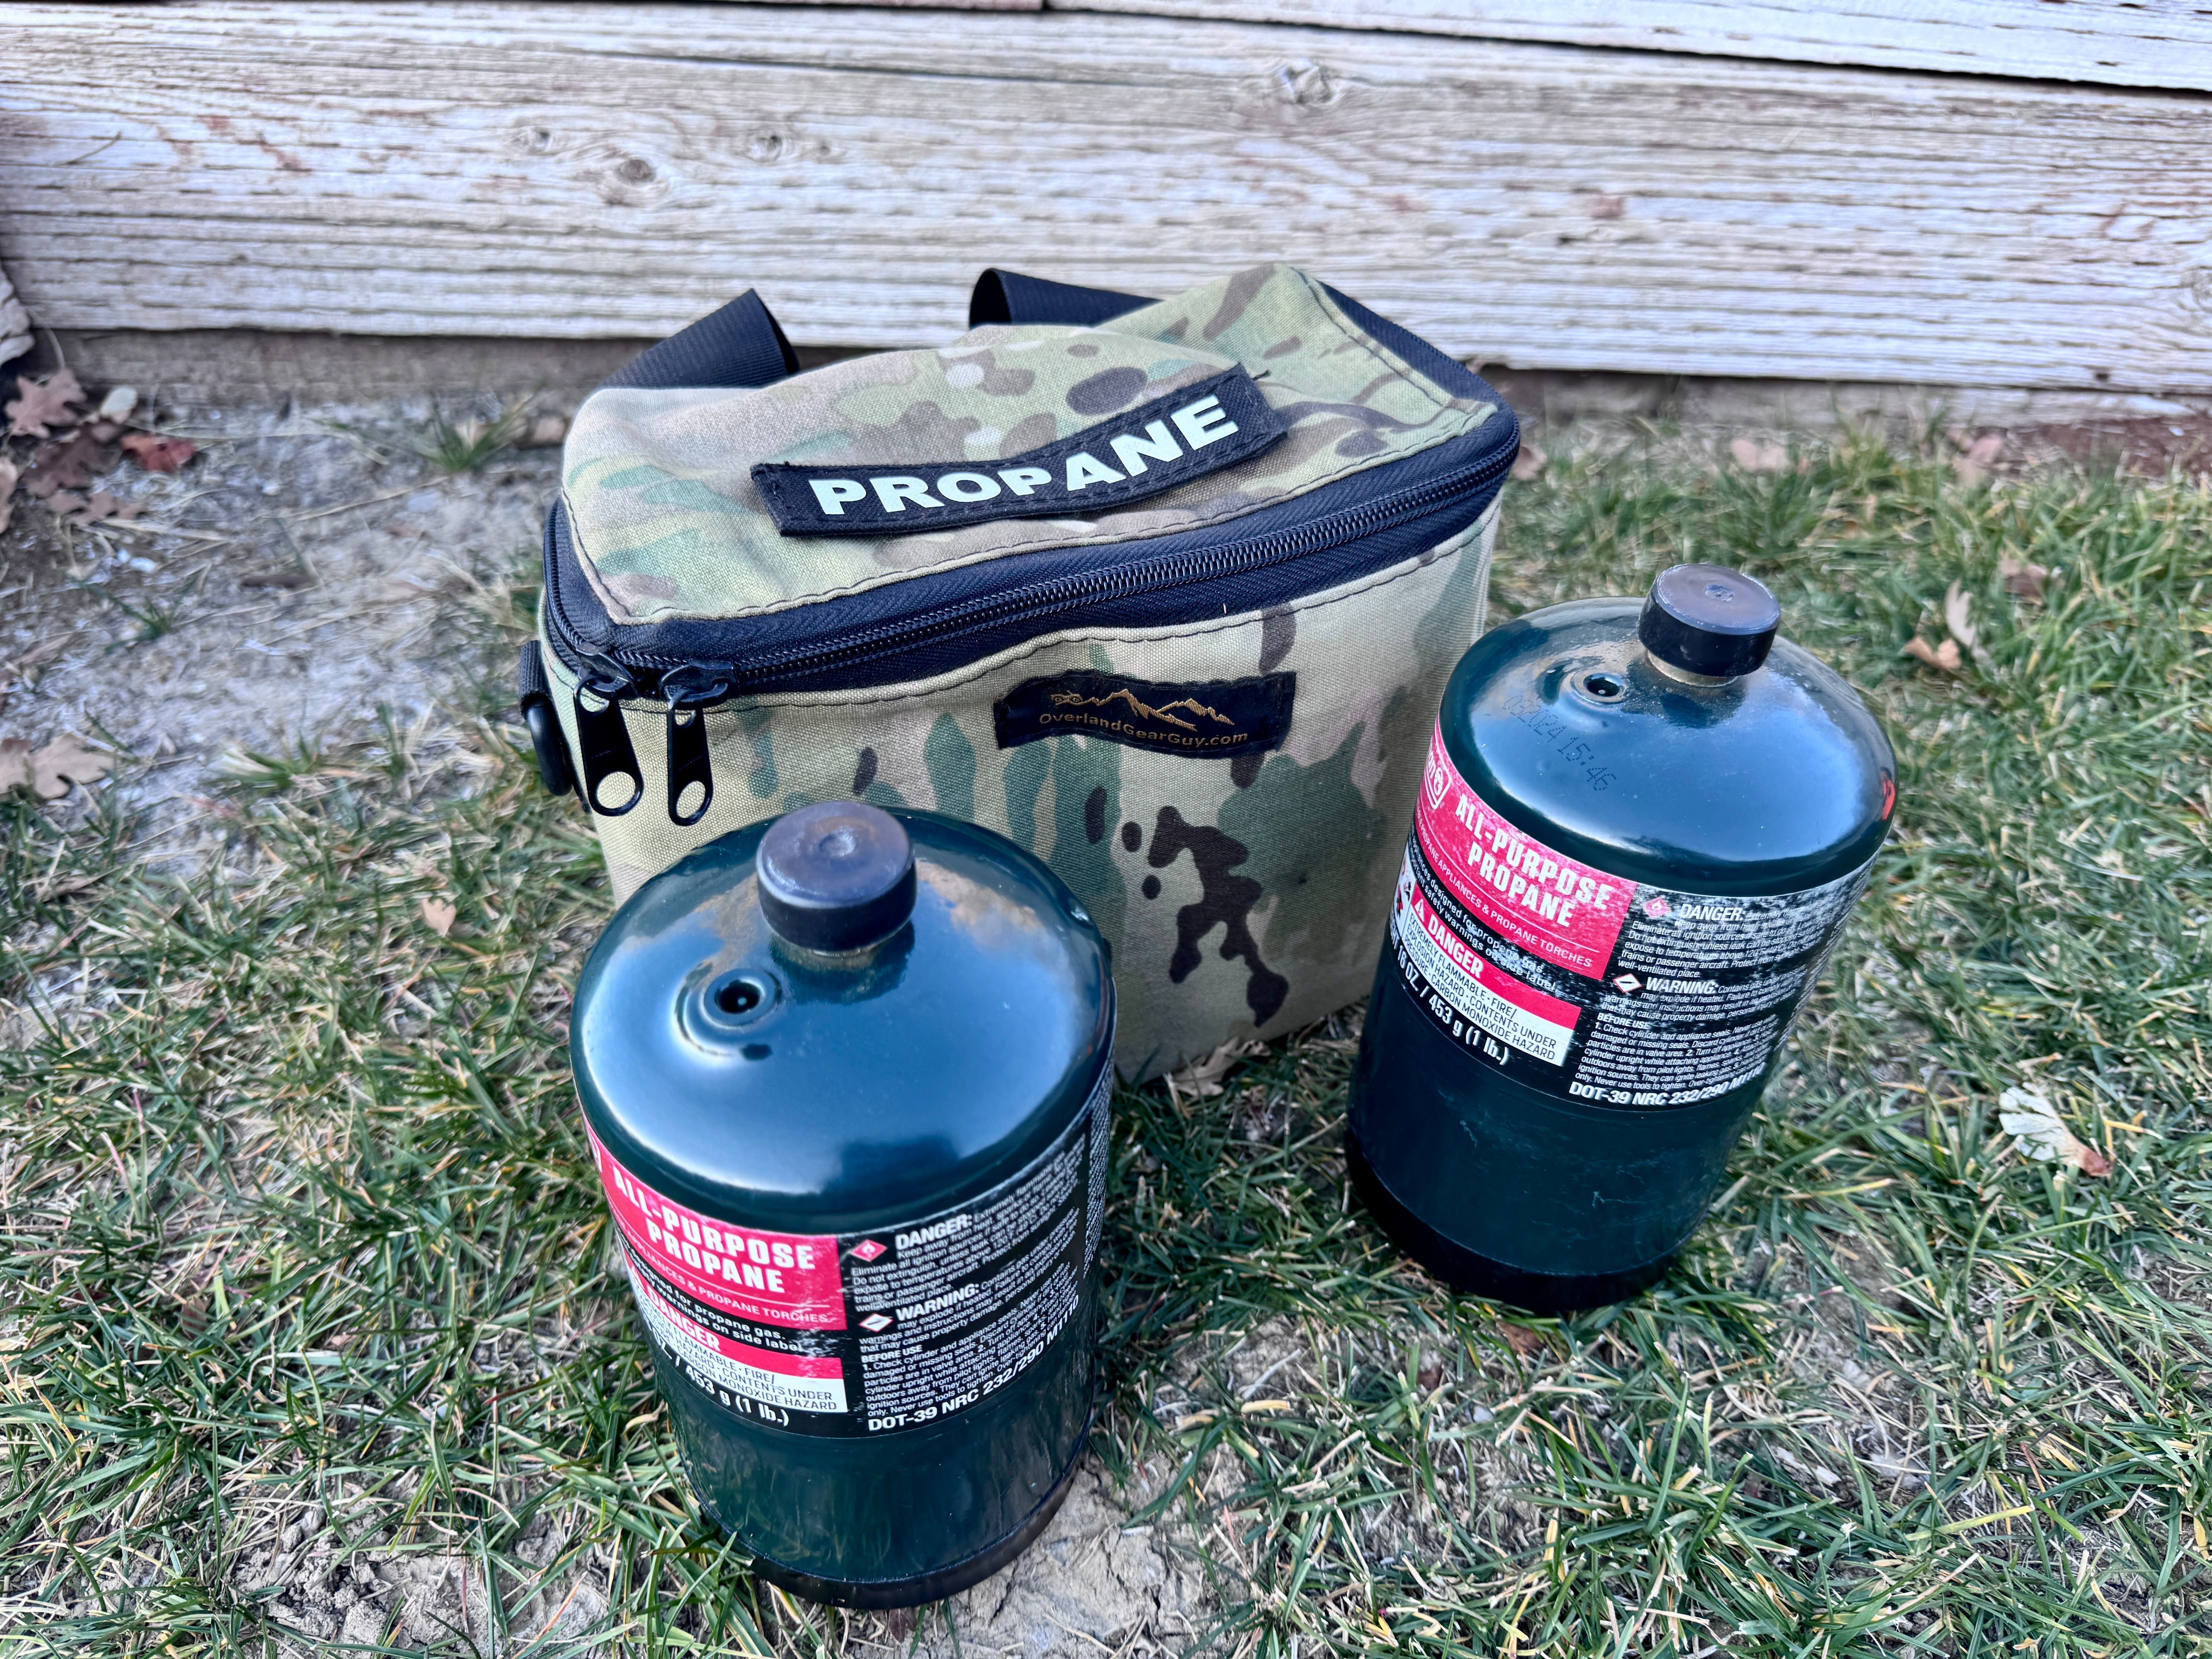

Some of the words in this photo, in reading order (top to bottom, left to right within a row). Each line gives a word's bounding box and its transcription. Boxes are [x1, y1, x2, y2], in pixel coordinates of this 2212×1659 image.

[808, 394, 1239, 516] PROPANE
[1039, 713, 1248, 748] OverlandGearGuy.com
[1558, 737, 1617, 790] 15:46
[1455, 793, 1614, 910] ALL-PURPOSE
[1431, 879, 1463, 918] designed
[1467, 841, 1575, 927] PROPANE
[1424, 885, 1444, 914] safety
[1445, 911, 1484, 951] warnings
[1438, 859, 1481, 908] APPLIANCES
[1482, 904, 1489, 915] &
[1491, 910, 1538, 945] PROPANE
[1540, 939, 1594, 967] TORCHES
[1632, 920, 1670, 935] Eliminate
[1682, 931, 1713, 941] ignition
[1680, 903, 1746, 921] DANGER:
[1409, 913, 1438, 957] EXTREMELY
[1439, 954, 1487, 998] FLAMMABLE
[1491, 998, 1517, 1019] FIRE/
[1428, 914, 1484, 979] DANGER
[1621, 949, 1644, 962] trains
[1656, 957, 1698, 972] passenger
[1625, 941, 1656, 953] expose
[1665, 949, 1719, 961] temperatures
[1407, 923, 1434, 969] EXPLOSION
[1434, 967, 1465, 997] HAZARD
[1470, 996, 1518, 1032] CONTENTS
[1520, 1026, 1556, 1049] UNDER
[1617, 959, 1677, 976] well-ventilated
[1646, 977, 1719, 994] WARNING:
[1718, 984, 1749, 993] Contains
[1404, 933, 1428, 975] PRESSURE
[1431, 975, 1461, 1008] CARBON
[1462, 1002, 1511, 1041] MONOXIDE
[1512, 1034, 1555, 1060] HAZARD
[1604, 994, 1640, 1008] warnings
[1640, 993, 1657, 1001] may
[1660, 995, 1690, 1003] explode
[1429, 994, 1453, 1025] 453
[1454, 1020, 1464, 1037] g
[1483, 1036, 1510, 1066] lb.)
[1597, 1012, 1632, 1027] BEFORE
[1603, 1024, 1629, 1036] Check
[1629, 1030, 1660, 1039] cylinder
[1637, 1011, 1661, 1019] cause
[1662, 1013, 1694, 1022] property
[1584, 1047, 1616, 1060] cylinder
[1615, 1053, 1644, 1064] upright
[1665, 1056, 1699, 1065] attaching
[1587, 1040, 1622, 1053] particles
[1645, 1048, 1665, 1057] valve
[1590, 1031, 1628, 1044] damaged
[1638, 1040, 1668, 1049] missing
[1691, 1038, 1718, 1048] Discard
[1578, 1063, 1607, 1077] ignition
[1642, 1074, 1659, 1082] They
[1581, 1056, 1616, 1069] outdoors
[1616, 1063, 1638, 1073] away
[1638, 1065, 1656, 1073] from
[1657, 1066, 1674, 1074] pilot
[1594, 1076, 1617, 1085] Never
[1569, 1081, 1633, 1104] DOT-39
[1632, 1092, 1671, 1105] NRC
[1668, 1081, 1731, 1104] 232/290
[612, 1166, 815, 1269] ALL-PURPOSE
[895, 1214, 973, 1250] DANGER:
[646, 1218, 785, 1293] PROPANE
[850, 1262, 897, 1276] Eliminate
[911, 1248, 947, 1267] ignition
[947, 1232, 984, 1254] sources
[854, 1293, 883, 1304] trains
[895, 1277, 945, 1298] passenger
[981, 1243, 1011, 1265] Protect
[939, 1250, 970, 1266] unless
[853, 1283, 889, 1295] expose
[902, 1259, 964, 1286] temperatures
[895, 1283, 979, 1322] WARNING:
[980, 1265, 1015, 1290] Contains
[647, 1285, 721, 1352] DANGER
[657, 1284, 710, 1326] warnings
[713, 1322, 729, 1335] on
[732, 1330, 762, 1345] side
[688, 1280, 697, 1291] &
[698, 1286, 762, 1316] PROPANE
[762, 1307, 828, 1323] TORCHES
[694, 1304, 750, 1332] propane
[897, 1320, 917, 1330] may
[919, 1307, 954, 1324] explode
[859, 1331, 903, 1345] warnings
[903, 1326, 922, 1336] and
[923, 1307, 975, 1331] instructions
[860, 1344, 880, 1353] that
[880, 1341, 901, 1350] may
[902, 1333, 930, 1345] cause
[931, 1318, 969, 1338] property
[674, 1324, 737, 1371] FLAMMABLE
[745, 1367, 775, 1384] FIRE/
[860, 1350, 902, 1363] BEFORE
[902, 1345, 923, 1356] USE
[863, 1365, 906, 1379] damaged
[919, 1352, 953, 1367] missing
[980, 1319, 1008, 1343] Discard
[867, 1407, 938, 1431] DOT-39
[941, 1388, 979, 1414] NRC
[983, 1341, 1044, 1395] 232/290
[1046, 1295, 1079, 1345] M1110
[872, 1359, 903, 1370] Check
[904, 1348, 939, 1364] cylinder
[940, 1341, 957, 1353] and
[958, 1322, 996, 1345] appliance
[677, 1336, 715, 1370] HAZARD
[722, 1368, 785, 1395] CONTENTS
[788, 1388, 833, 1400] UNDER
[677, 1346, 716, 1379] CARBON
[719, 1374, 781, 1404] MONOXIDE
[784, 1398, 837, 1410] HAZARD
[864, 1375, 904, 1387] particles
[931, 1359, 954, 1372] valve
[865, 1383, 901, 1395] cylinder
[902, 1374, 934, 1389] upright
[934, 1367, 958, 1379] while
[959, 1346, 996, 1369] attaching
[865, 1390, 906, 1402] outdoors
[907, 1384, 931, 1396] away
[932, 1377, 953, 1388] from
[954, 1369, 972, 1381] pilot
[866, 1399, 900, 1411] ignition
[939, 1380, 960, 1393] They
[978, 1360, 999, 1374] ignite
[1000, 1340, 1025, 1363] leaking
[890, 1403, 917, 1414] Never
[917, 1398, 934, 1407] use
[934, 1390, 955, 1402] tools
[997, 1329, 1046, 1372] Over-tightening
[685, 1365, 715, 1395] 453
[719, 1390, 731, 1407] g
[759, 1403, 789, 1427] lb.)
